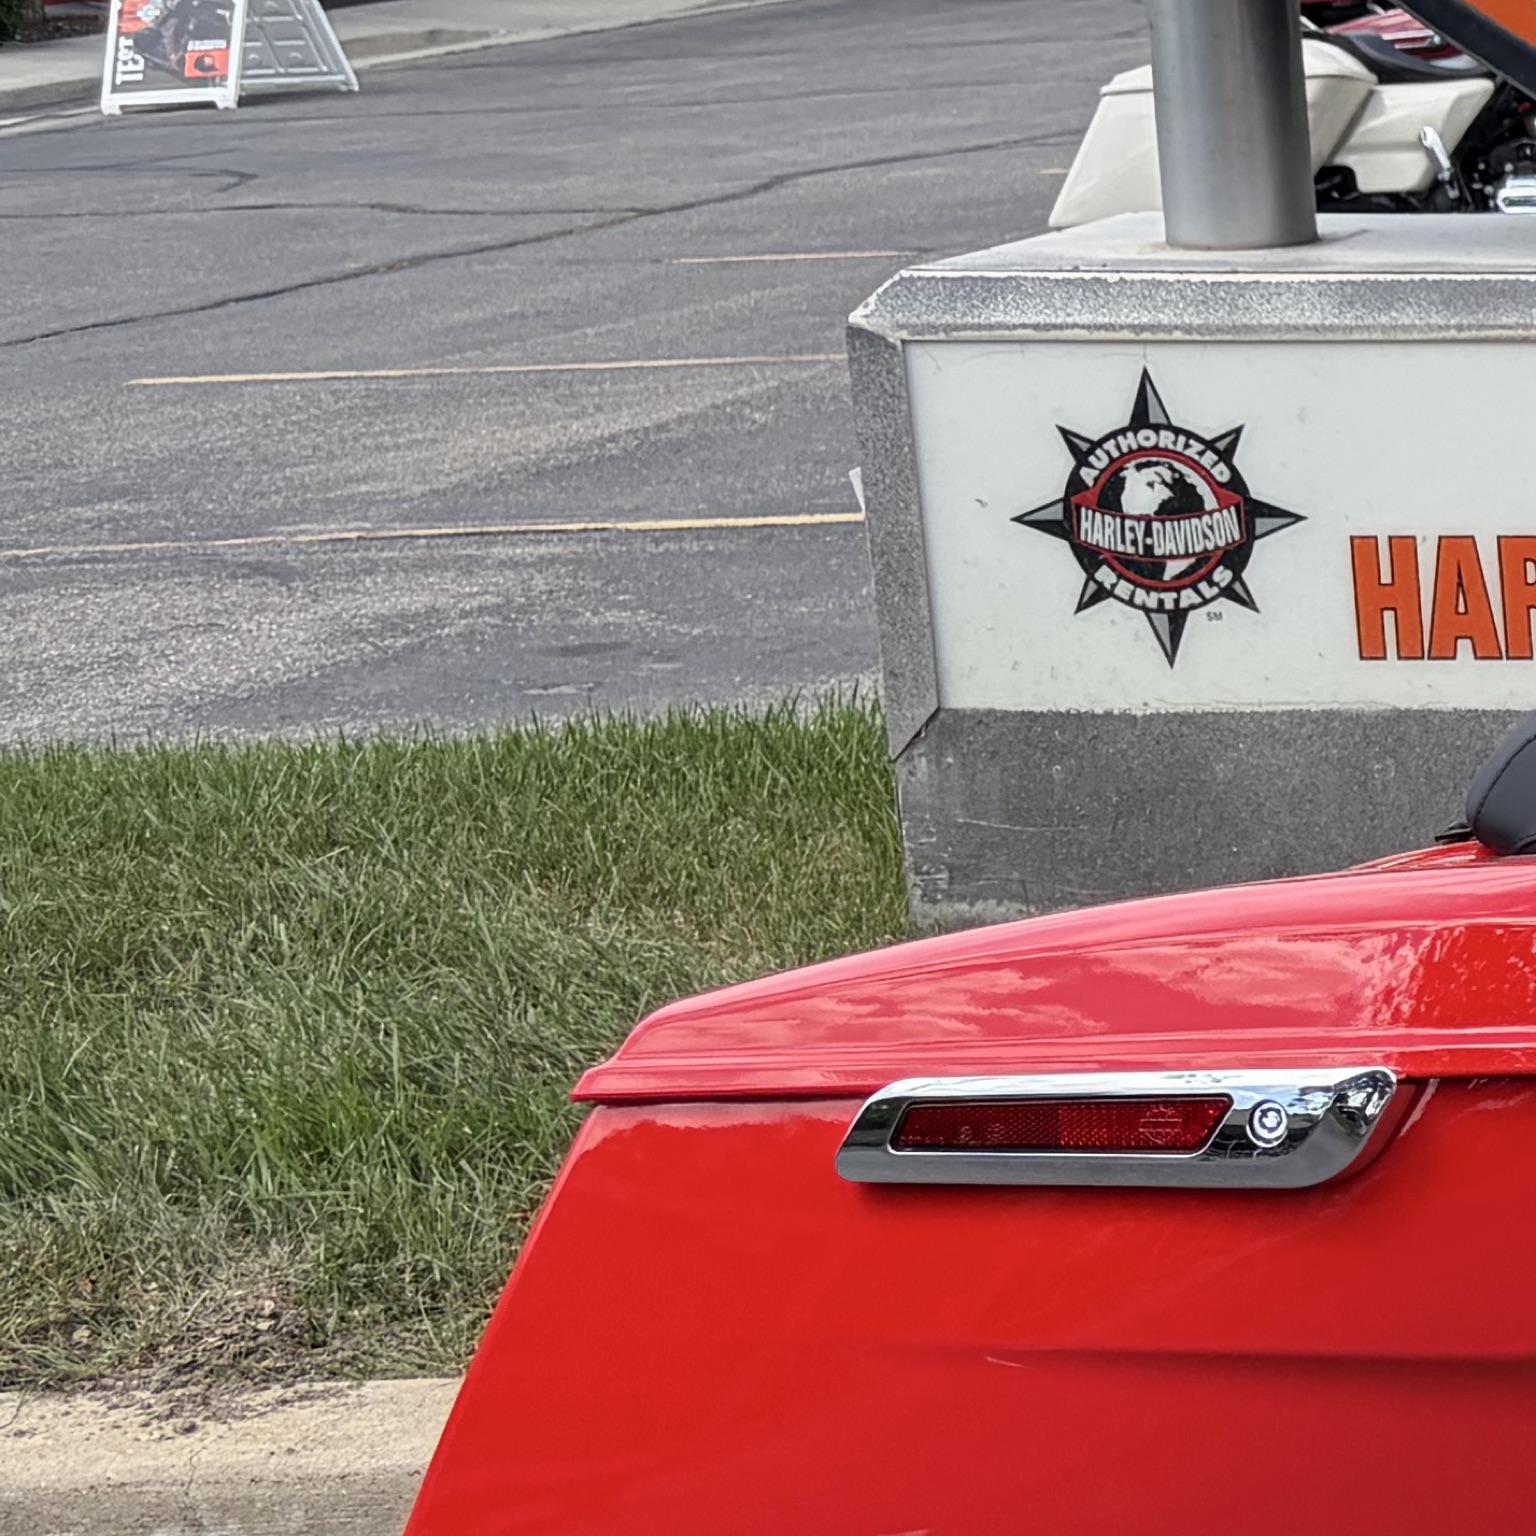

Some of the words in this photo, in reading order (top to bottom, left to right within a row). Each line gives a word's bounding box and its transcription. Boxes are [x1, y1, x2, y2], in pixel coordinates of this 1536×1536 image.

[1079, 429, 1233, 487] AUTHORIZED
[1079, 506, 1241, 556] HARLEY-DAVIDSON
[1094, 565, 1234, 610] RENTALS
